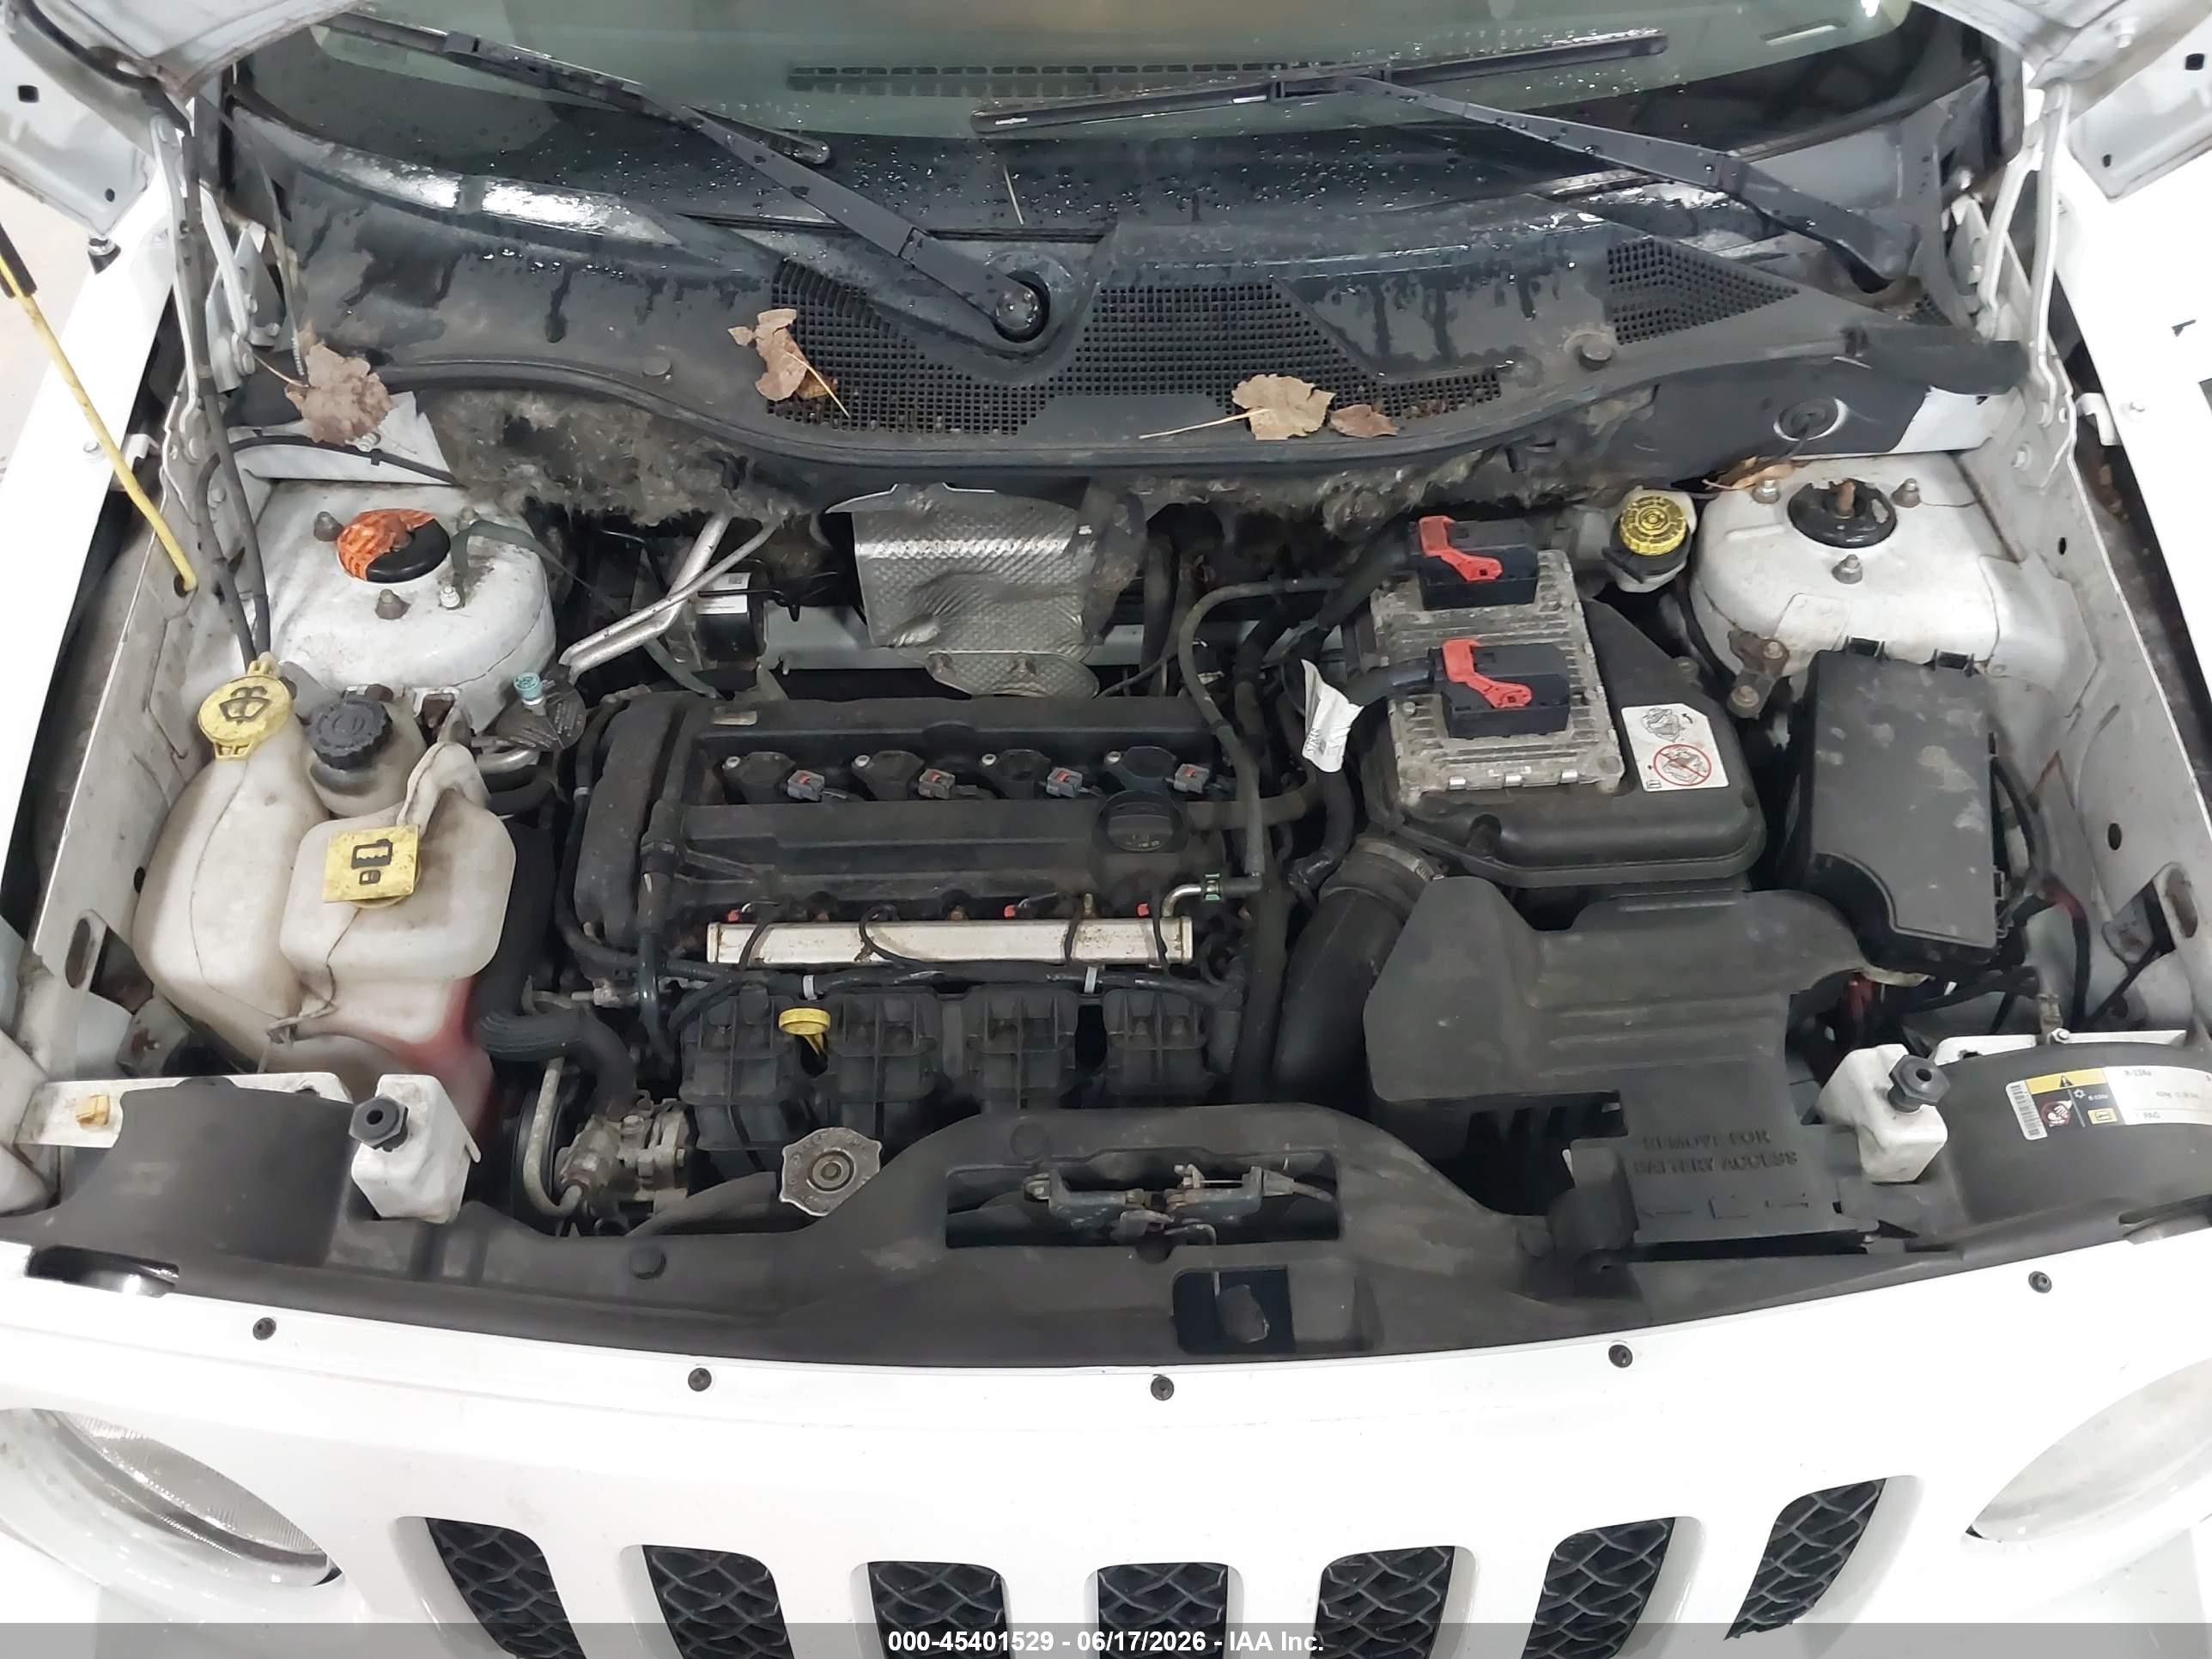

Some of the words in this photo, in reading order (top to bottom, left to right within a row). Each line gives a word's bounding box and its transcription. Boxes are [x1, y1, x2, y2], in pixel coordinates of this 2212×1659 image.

[1642, 1134, 1718, 1150] REMOVE
[1729, 1129, 1772, 1146] FOR
[1633, 1158, 1715, 1175] BATTERY
[1721, 1151, 1798, 1171] ACCESS
